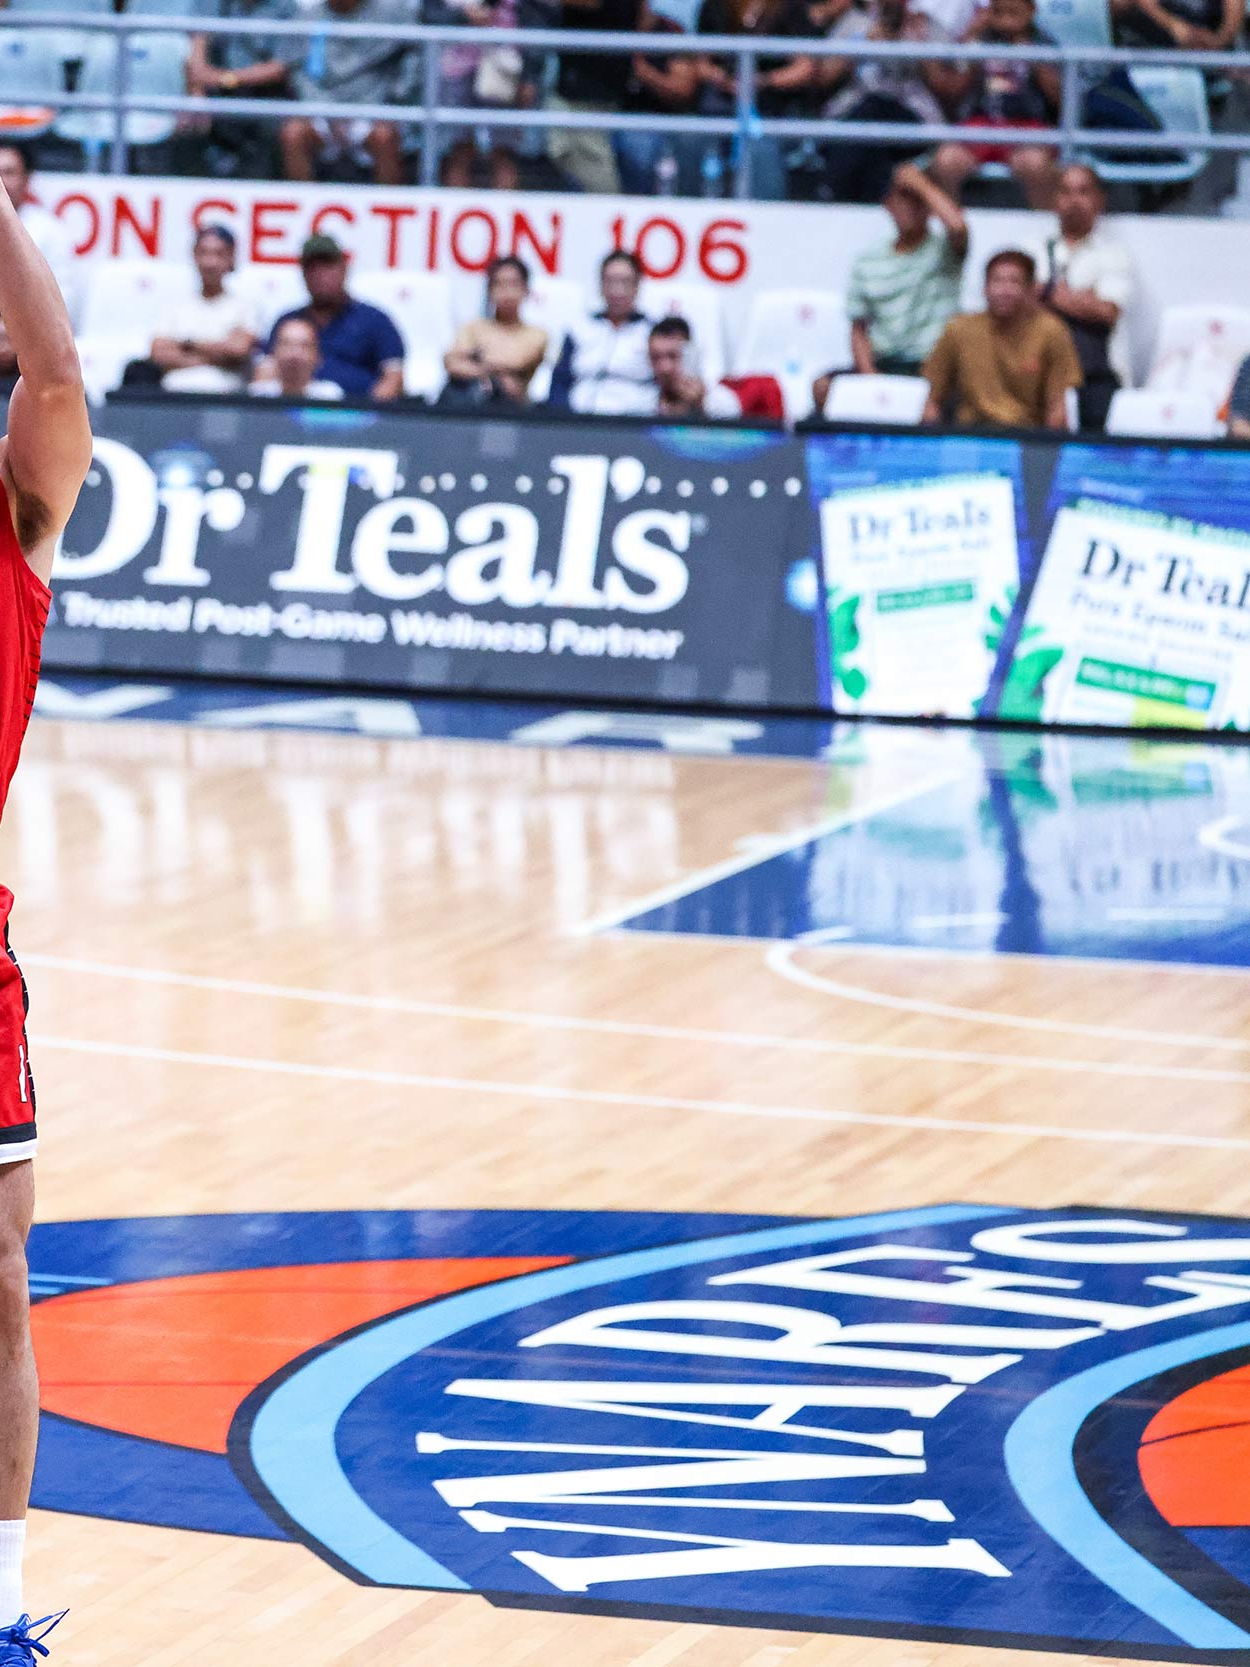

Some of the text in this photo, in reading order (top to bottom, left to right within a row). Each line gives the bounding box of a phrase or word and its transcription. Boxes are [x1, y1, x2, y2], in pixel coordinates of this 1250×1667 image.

[258, 443, 693, 614] Teal's
[1078, 535, 1148, 588] Dr
[391, 609, 547, 653] Wellness
[550, 618, 685, 660] Partner
[415, 1218, 1250, 1593] YNARES
